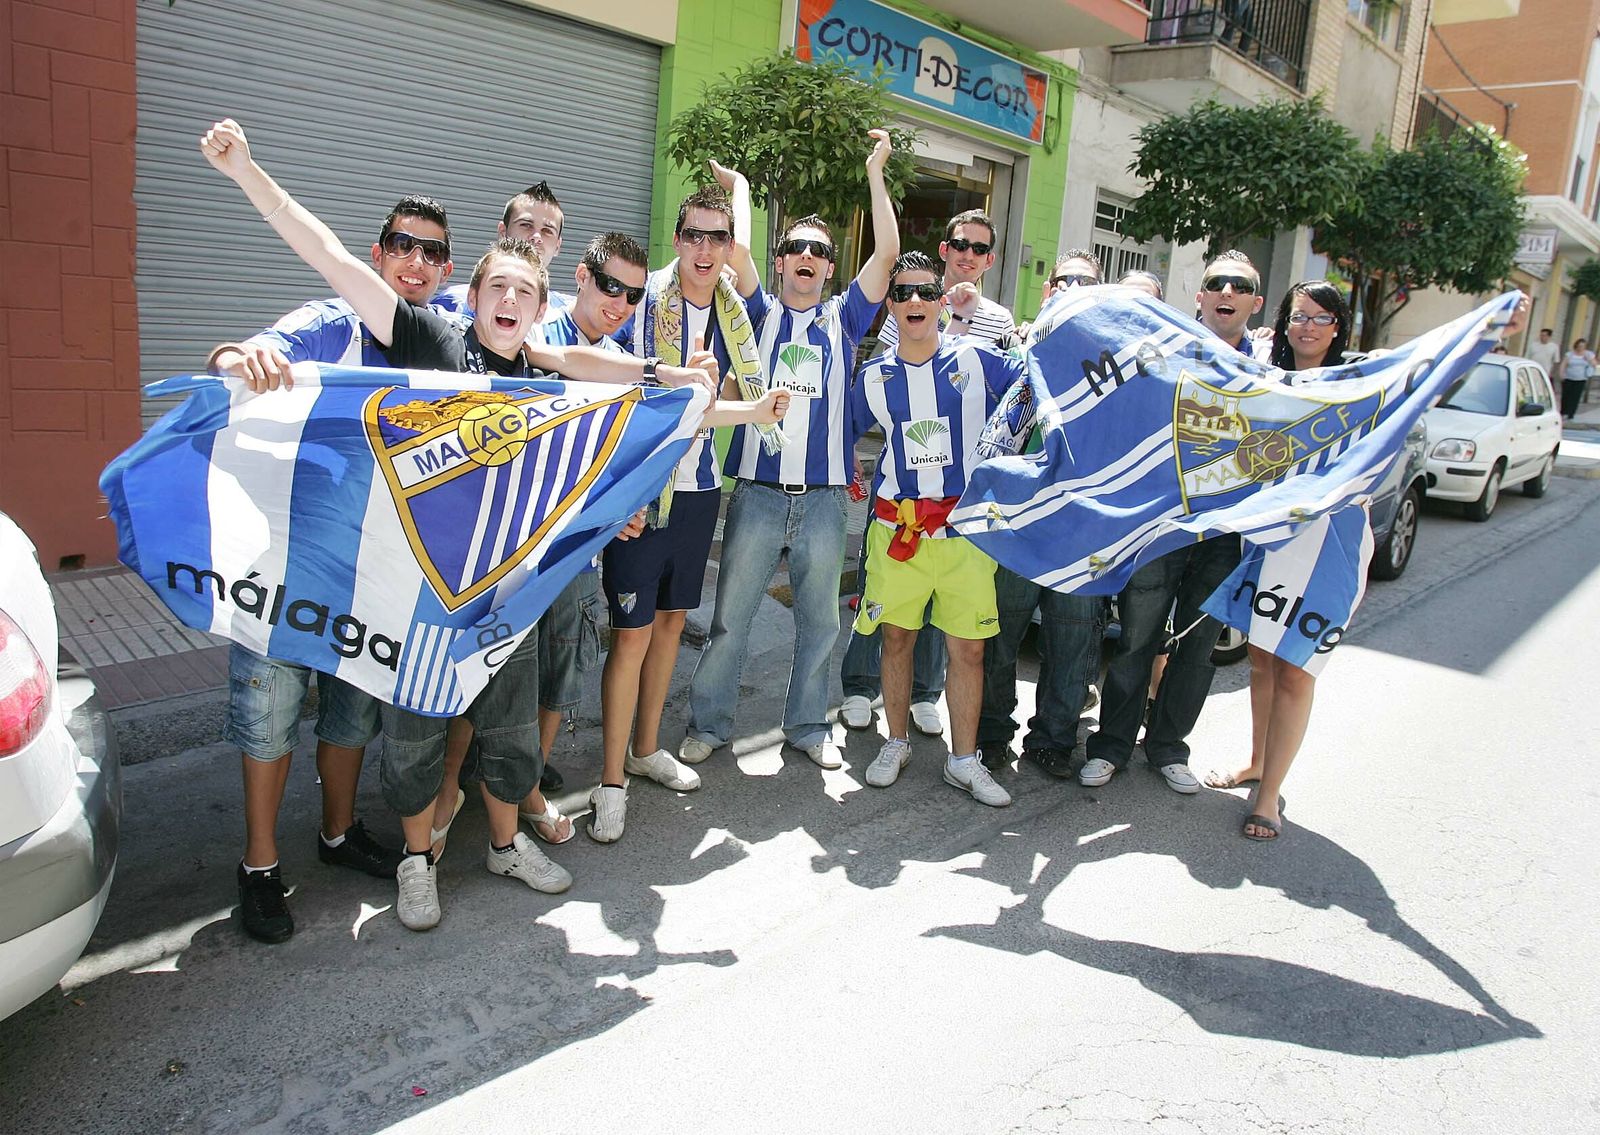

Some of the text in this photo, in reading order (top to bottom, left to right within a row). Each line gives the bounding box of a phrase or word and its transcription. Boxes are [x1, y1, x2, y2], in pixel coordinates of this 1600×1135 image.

[817, 17, 1029, 117] CORTI-DECOR
[413, 405, 547, 476] MALAGA
[910, 451, 949, 465] Unicaja
[166, 559, 402, 673] málaga
